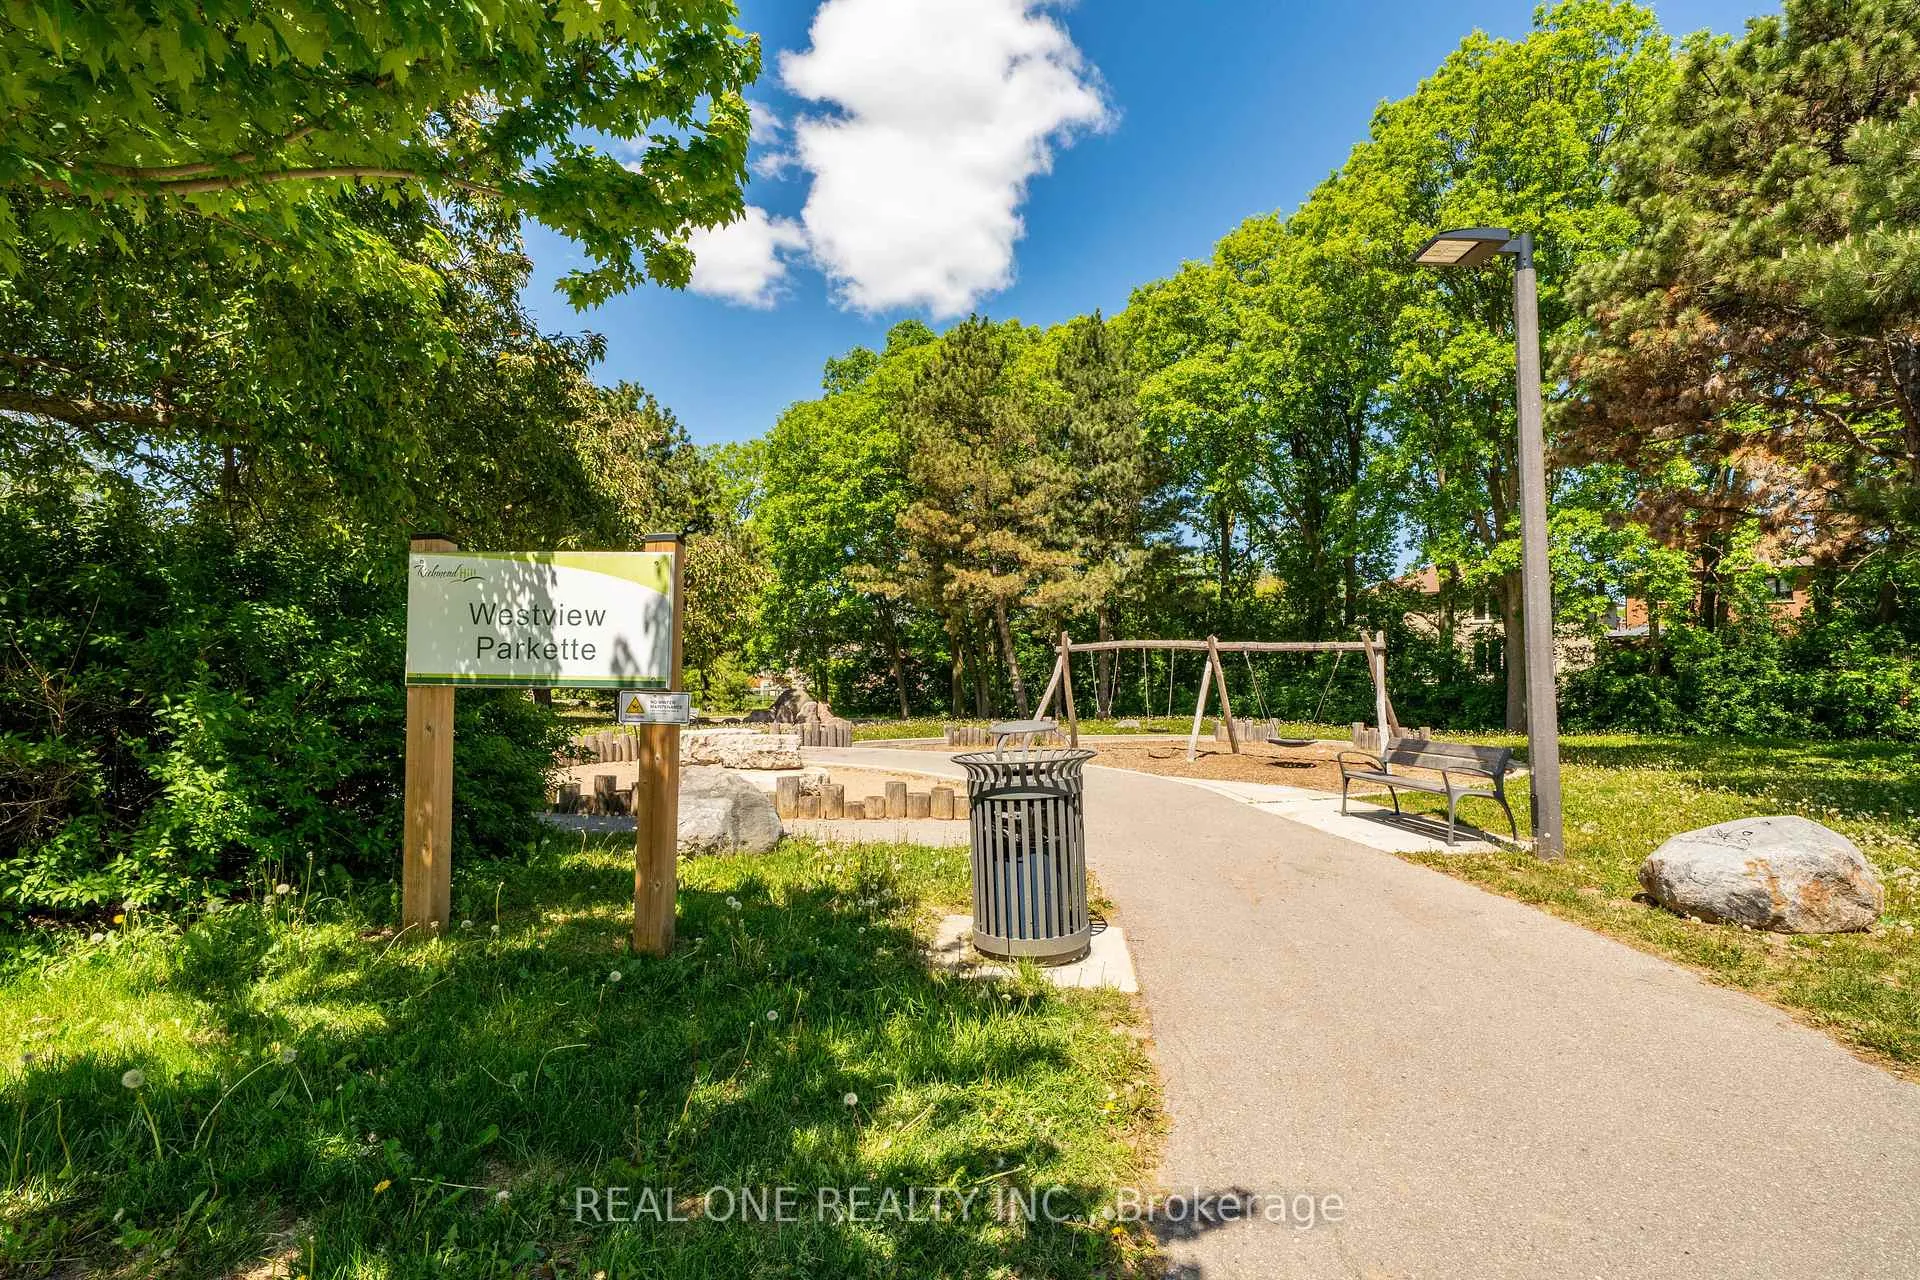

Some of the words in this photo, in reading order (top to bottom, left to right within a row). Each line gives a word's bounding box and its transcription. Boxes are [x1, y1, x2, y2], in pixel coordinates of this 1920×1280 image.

[414, 561, 463, 578] Richmond
[469, 602, 606, 626] Westview
[477, 636, 596, 660] Parkette
